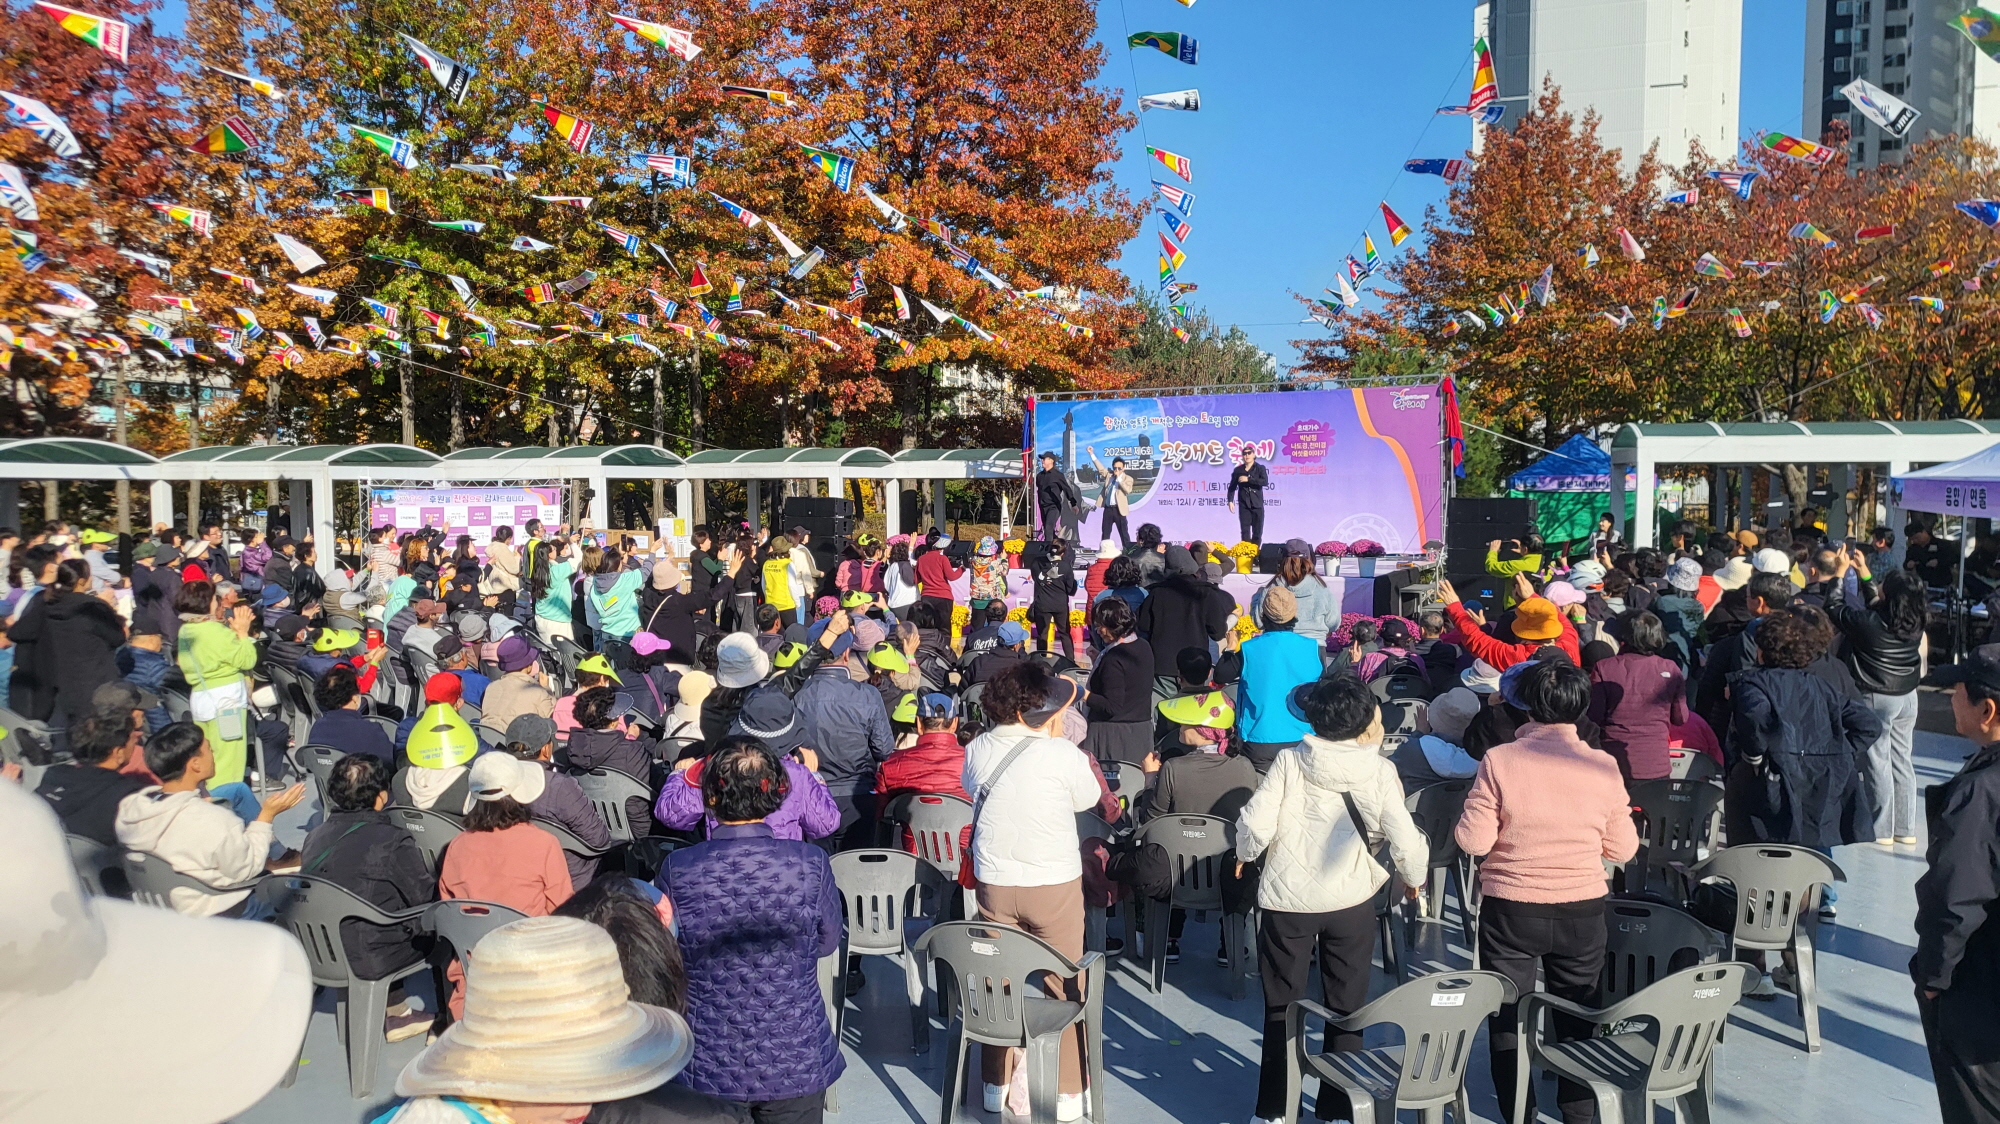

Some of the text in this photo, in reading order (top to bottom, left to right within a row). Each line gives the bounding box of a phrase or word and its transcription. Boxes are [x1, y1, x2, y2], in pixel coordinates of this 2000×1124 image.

[451, 69, 467, 100] elcome
[1471, 88, 1497, 107] come
[1181, 194, 1192, 214] come
[1201, 412, 1221, 428] 토요일
[1223, 415, 1240, 427] 만남
[1103, 445, 1154, 457] 2025년 제6회
[1159, 440, 1224, 471] 광개토
[429, 494, 451, 504] 후원을
[453, 493, 482, 504] 진심으로
[1946, 486, 1960, 507] 음향
[1970, 488, 1987, 510] 연출
